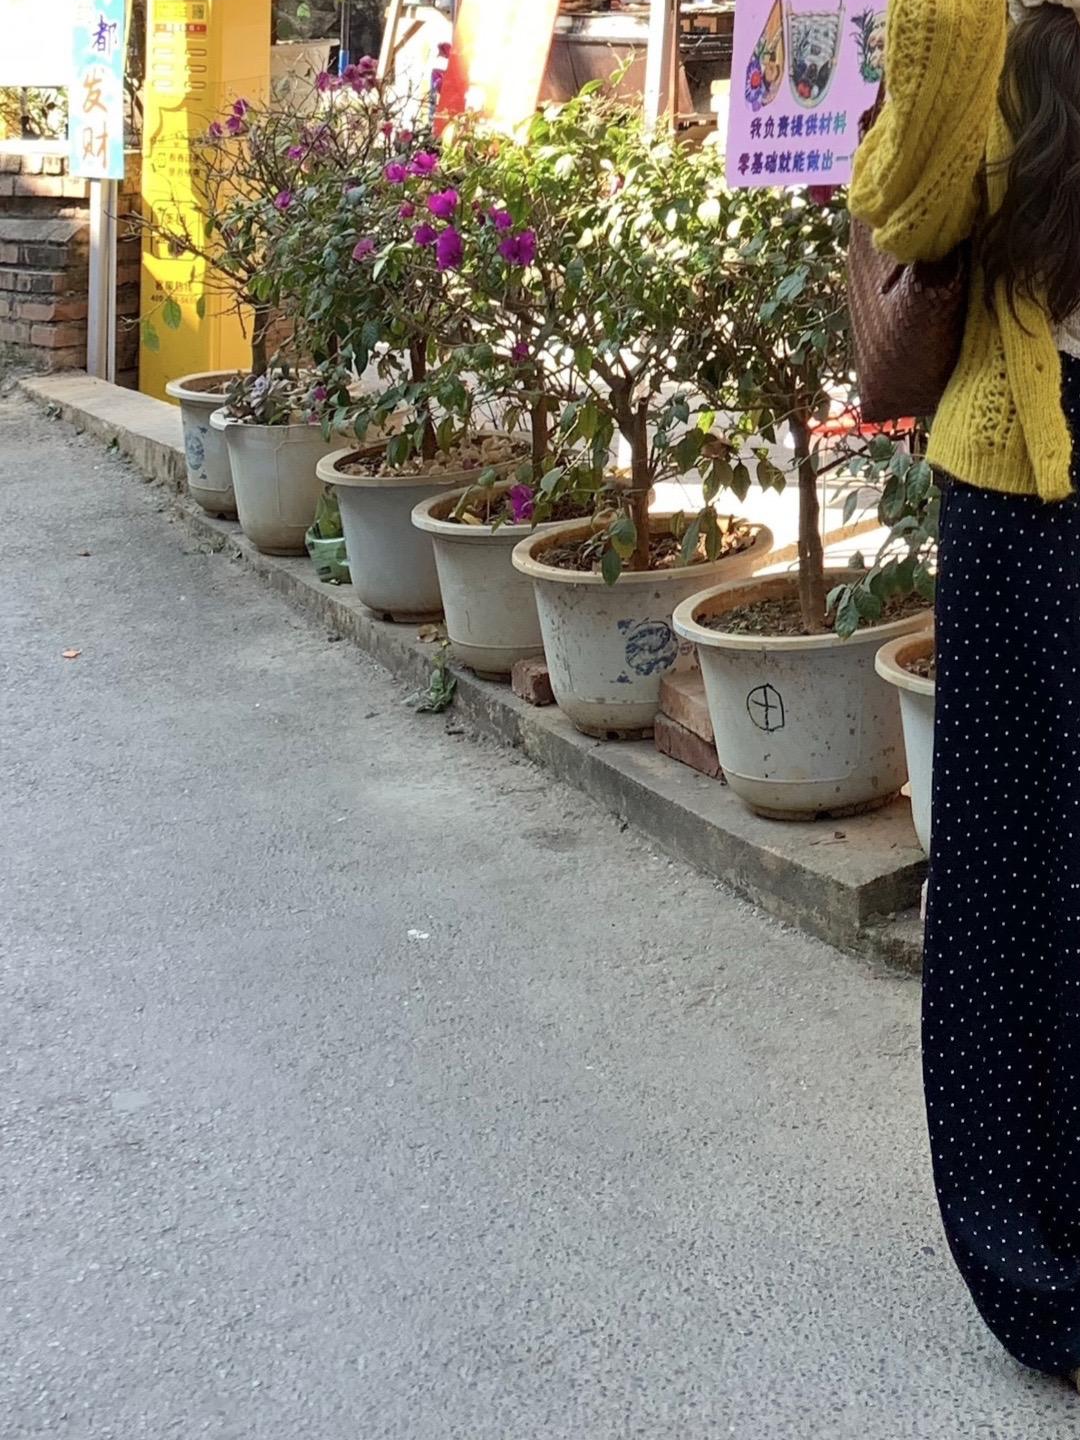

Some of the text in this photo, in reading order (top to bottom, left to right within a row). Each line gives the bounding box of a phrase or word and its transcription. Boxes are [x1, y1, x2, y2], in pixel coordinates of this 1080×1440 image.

[750, 110, 847, 140] 我负责提供材料
[737, 149, 855, 176] 零基础就能做出一
